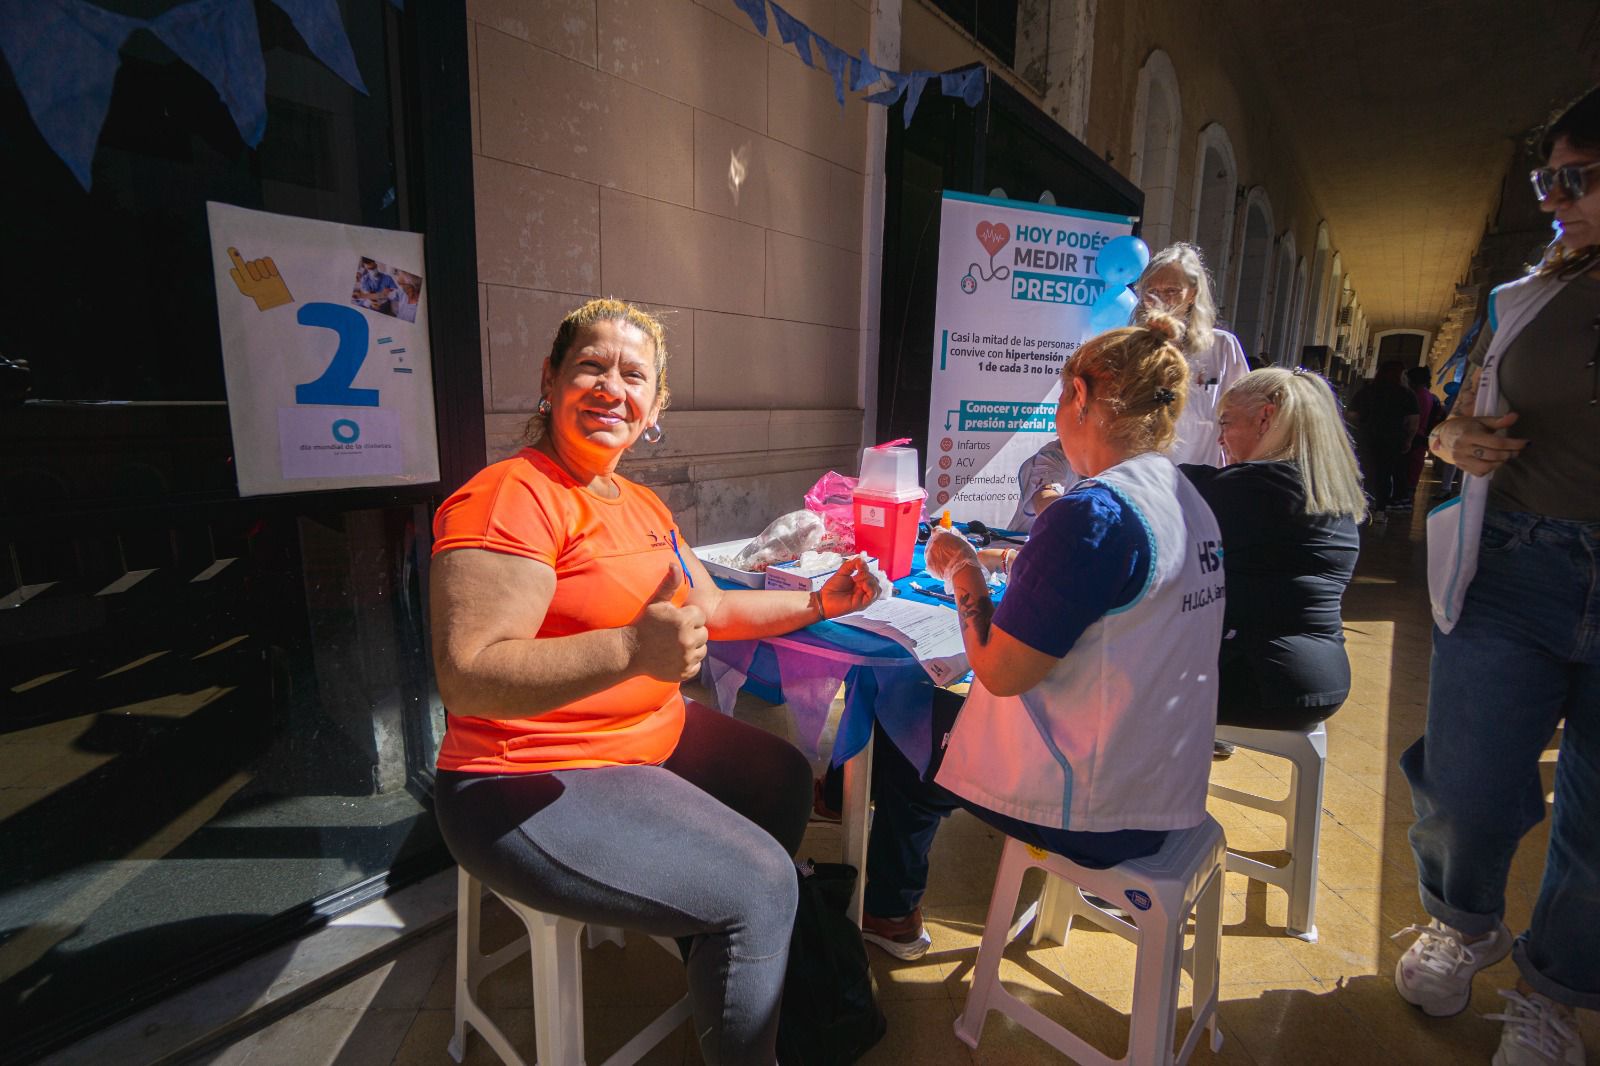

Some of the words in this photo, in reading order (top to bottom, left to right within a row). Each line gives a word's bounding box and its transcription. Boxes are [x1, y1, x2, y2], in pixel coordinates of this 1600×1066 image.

[1015, 224, 1052, 244] HOY
[1014, 247, 1078, 273] MEDIR
[1083, 255, 1098, 275] T
[1012, 277, 1104, 305] PRESIÓN
[951, 332, 970, 343] Casi
[972, 332, 980, 344] la
[982, 334, 1009, 345] mitad
[1010, 335, 1022, 346] de
[1023, 336, 1036, 347] las
[1037, 339, 1075, 350] personas
[296, 302, 379, 407] 2
[950, 346, 986, 358] convive
[987, 350, 1004, 359] con
[1005, 349, 1064, 362] hipertensión
[978, 361, 984, 371] 1
[985, 361, 998, 372] de
[999, 363, 1022, 373] cada
[1023, 364, 1030, 374] 3
[1031, 366, 1043, 374] no
[1044, 365, 1054, 375] lo
[966, 402, 1011, 414] Conocer
[1012, 406, 1020, 416] y
[965, 417, 1006, 430] presión
[1007, 418, 1047, 429] arterial
[957, 440, 991, 450] Infartos
[956, 457, 976, 468] ACV
[955, 475, 1006, 485] Enfermedad
[953, 491, 1006, 502] Afectaciones
[1197, 540, 1222, 574] HS
